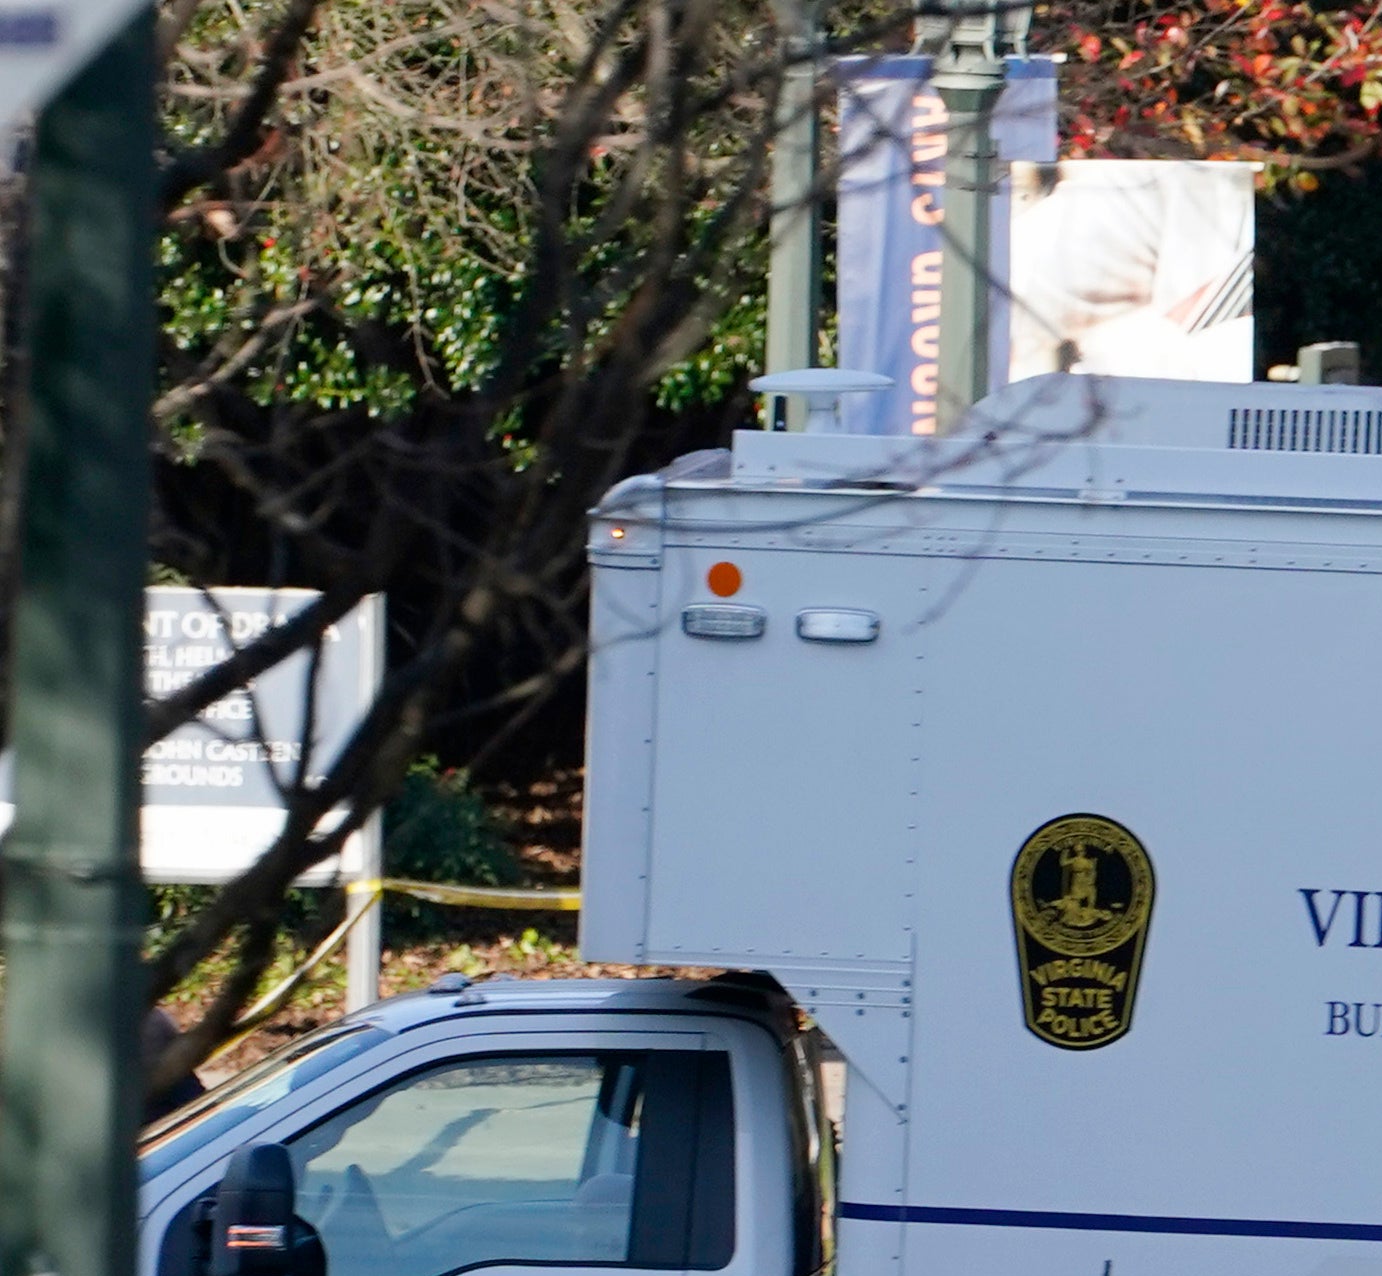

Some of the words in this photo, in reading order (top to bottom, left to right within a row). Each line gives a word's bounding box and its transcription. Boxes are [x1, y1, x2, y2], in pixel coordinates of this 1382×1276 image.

[1030, 957, 1129, 993] VIRGINIA
[1040, 986, 1113, 1010] STATE
[1035, 1007, 1121, 1038] POLICE
